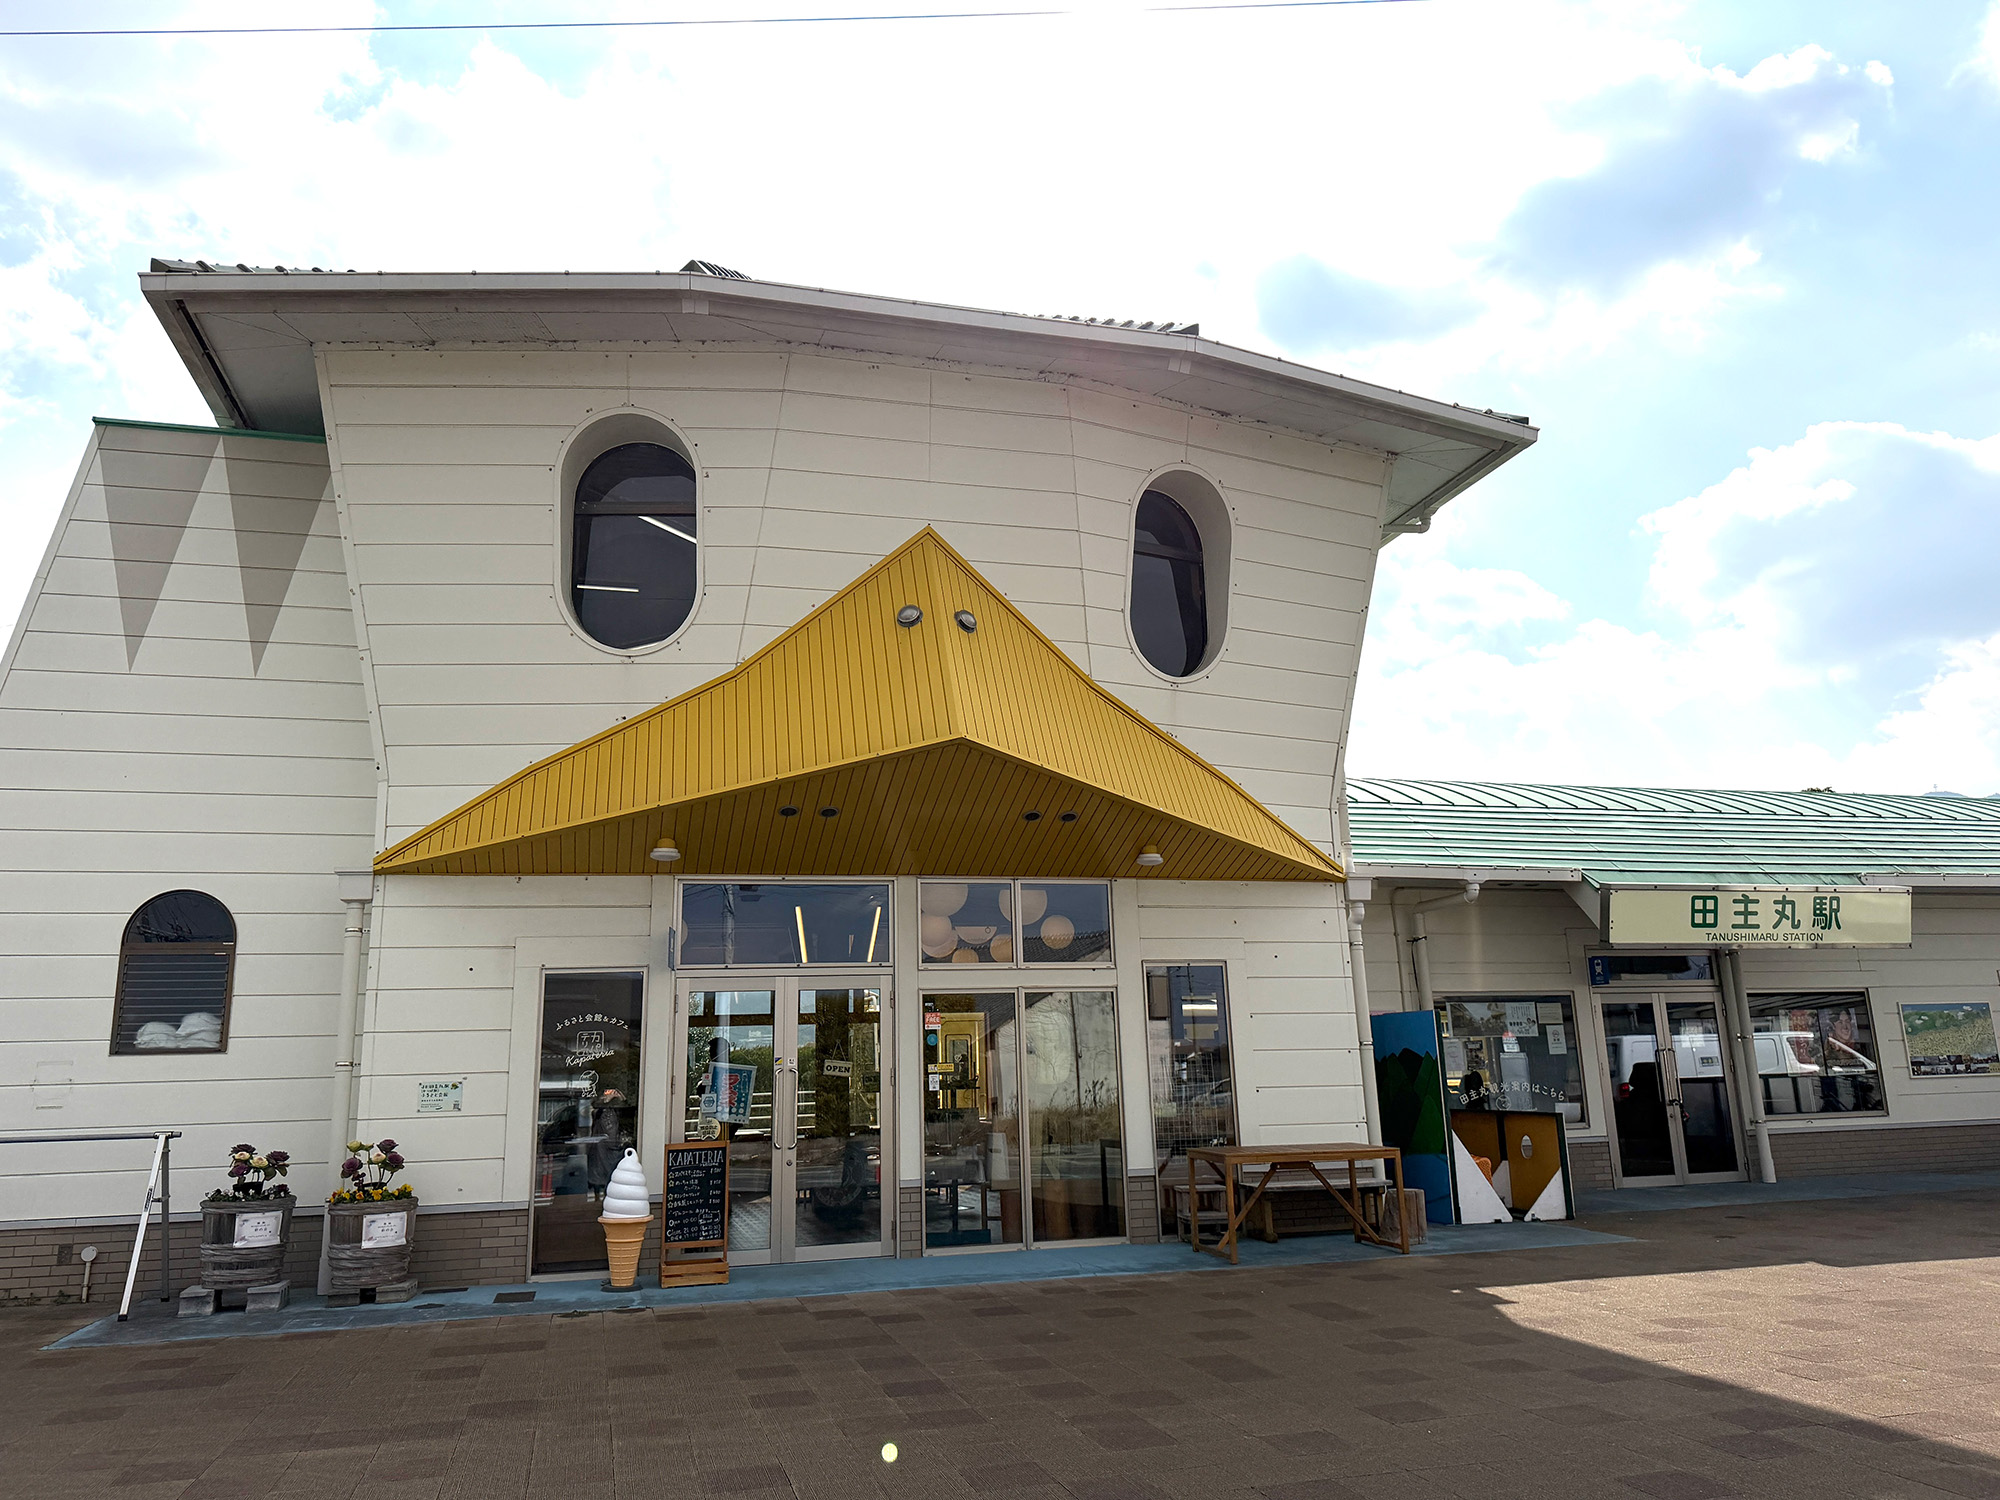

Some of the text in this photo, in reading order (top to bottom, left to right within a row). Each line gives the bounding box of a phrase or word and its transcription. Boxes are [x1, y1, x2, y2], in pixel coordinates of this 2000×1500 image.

[1691, 894, 1841, 930] 田主丸駅
[1705, 932, 1824, 942] TANUSHIMARU STATION
[826, 1065, 851, 1074] OPEN
[1459, 1081, 1565, 1106] 田主丸観光案内はこちら
[669, 1150, 724, 1166] KAPATERIA
